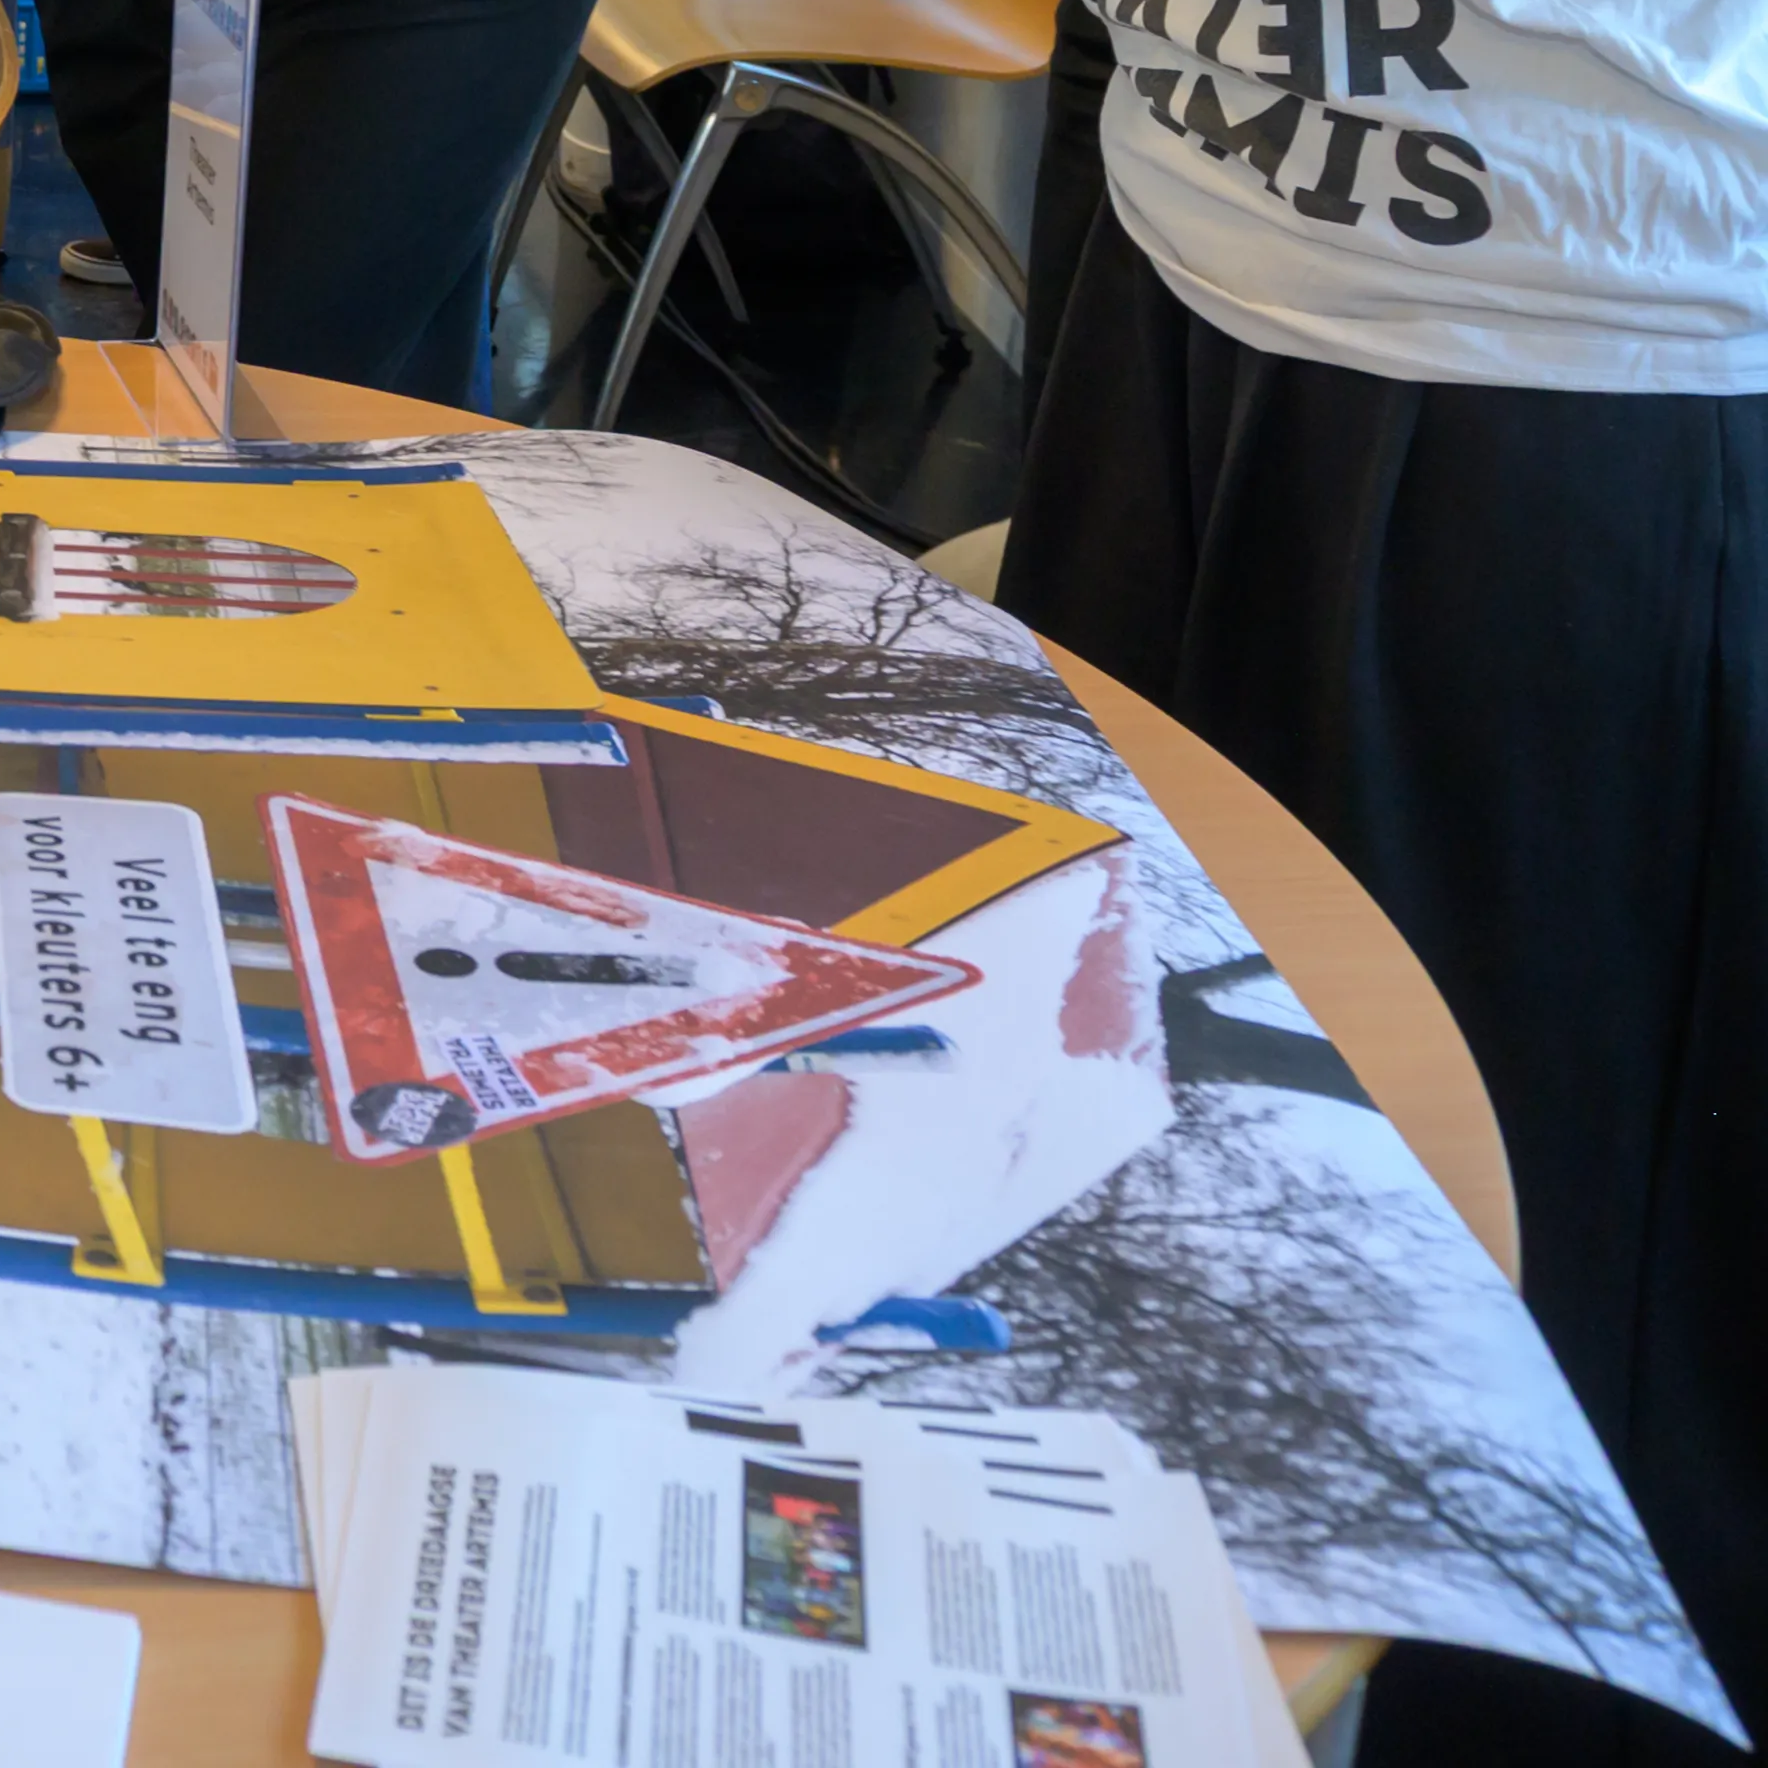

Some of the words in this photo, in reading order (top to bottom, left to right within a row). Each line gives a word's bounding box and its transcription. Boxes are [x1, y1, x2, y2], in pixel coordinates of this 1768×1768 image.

[22, 816, 70, 880] voor
[113, 858, 176, 924] Veel
[29, 889, 92, 1032] kleuters
[124, 936, 178, 969] te
[118, 981, 183, 1046] eng
[46, 1044, 105, 1093] 6+
[464, 1469, 500, 1575] ARTEMIS
[407, 1615, 438, 1650] DE
[448, 1575, 487, 1680] THEATER
[402, 1652, 434, 1683] IS
[395, 1684, 430, 1732] DIT
[441, 1684, 474, 1739] VAN
